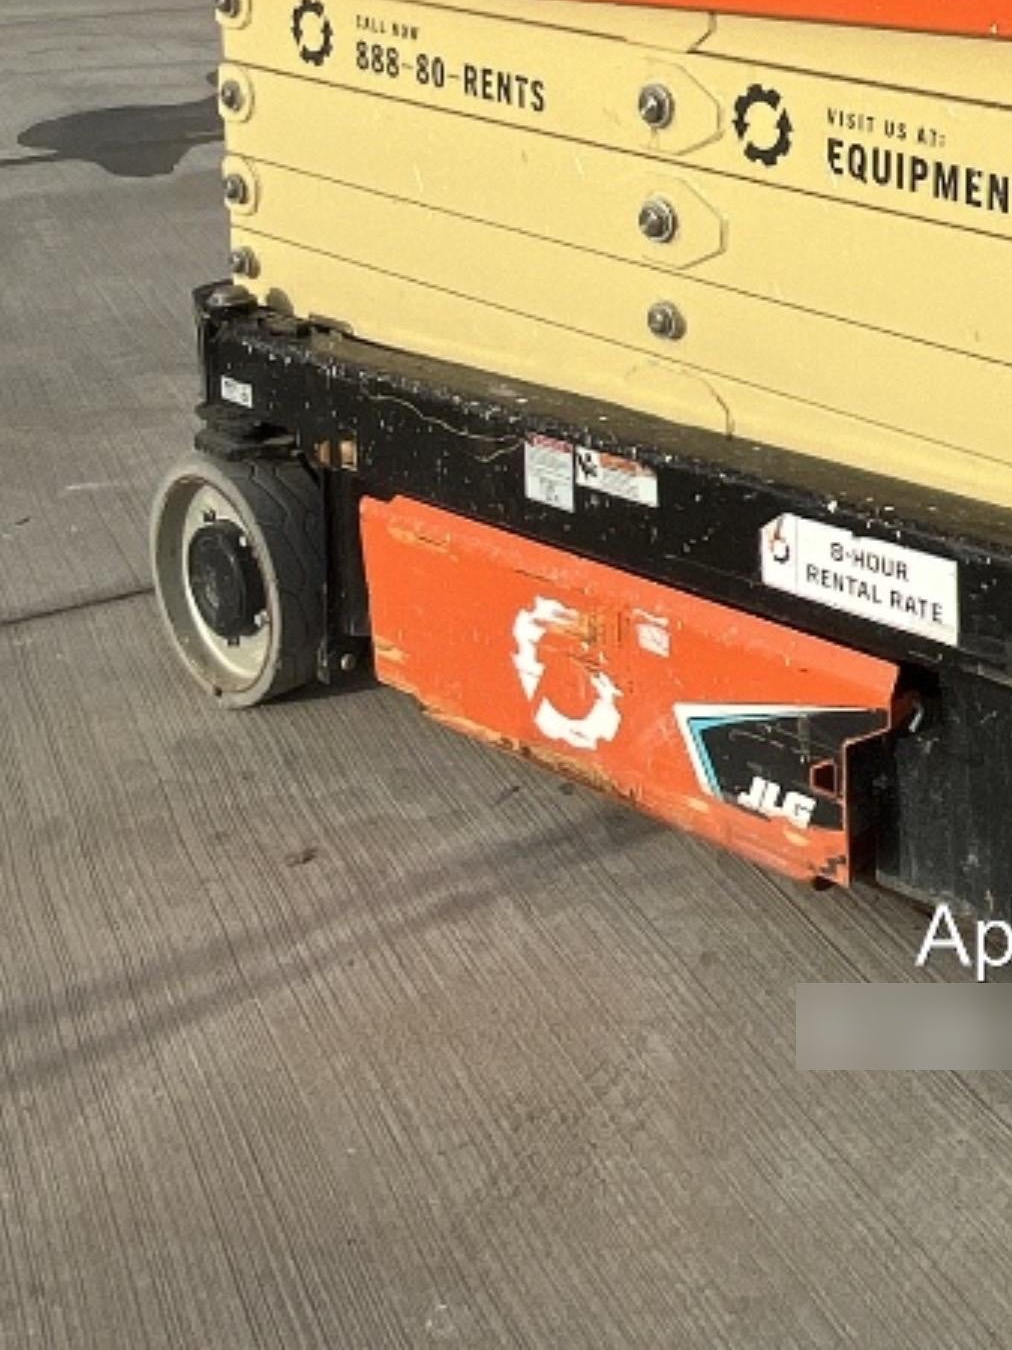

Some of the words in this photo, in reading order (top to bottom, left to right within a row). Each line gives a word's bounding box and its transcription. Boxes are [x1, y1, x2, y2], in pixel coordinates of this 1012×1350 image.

[356, 40, 545, 112] 888-80-RENTS
[827, 107, 875, 133] VISIT
[884, 119, 907, 140] US
[830, 542, 910, 582] 8-HOUR
[806, 563, 882, 605] RENTAL
[890, 589, 943, 625] RATE
[737, 776, 816, 829] JLG
